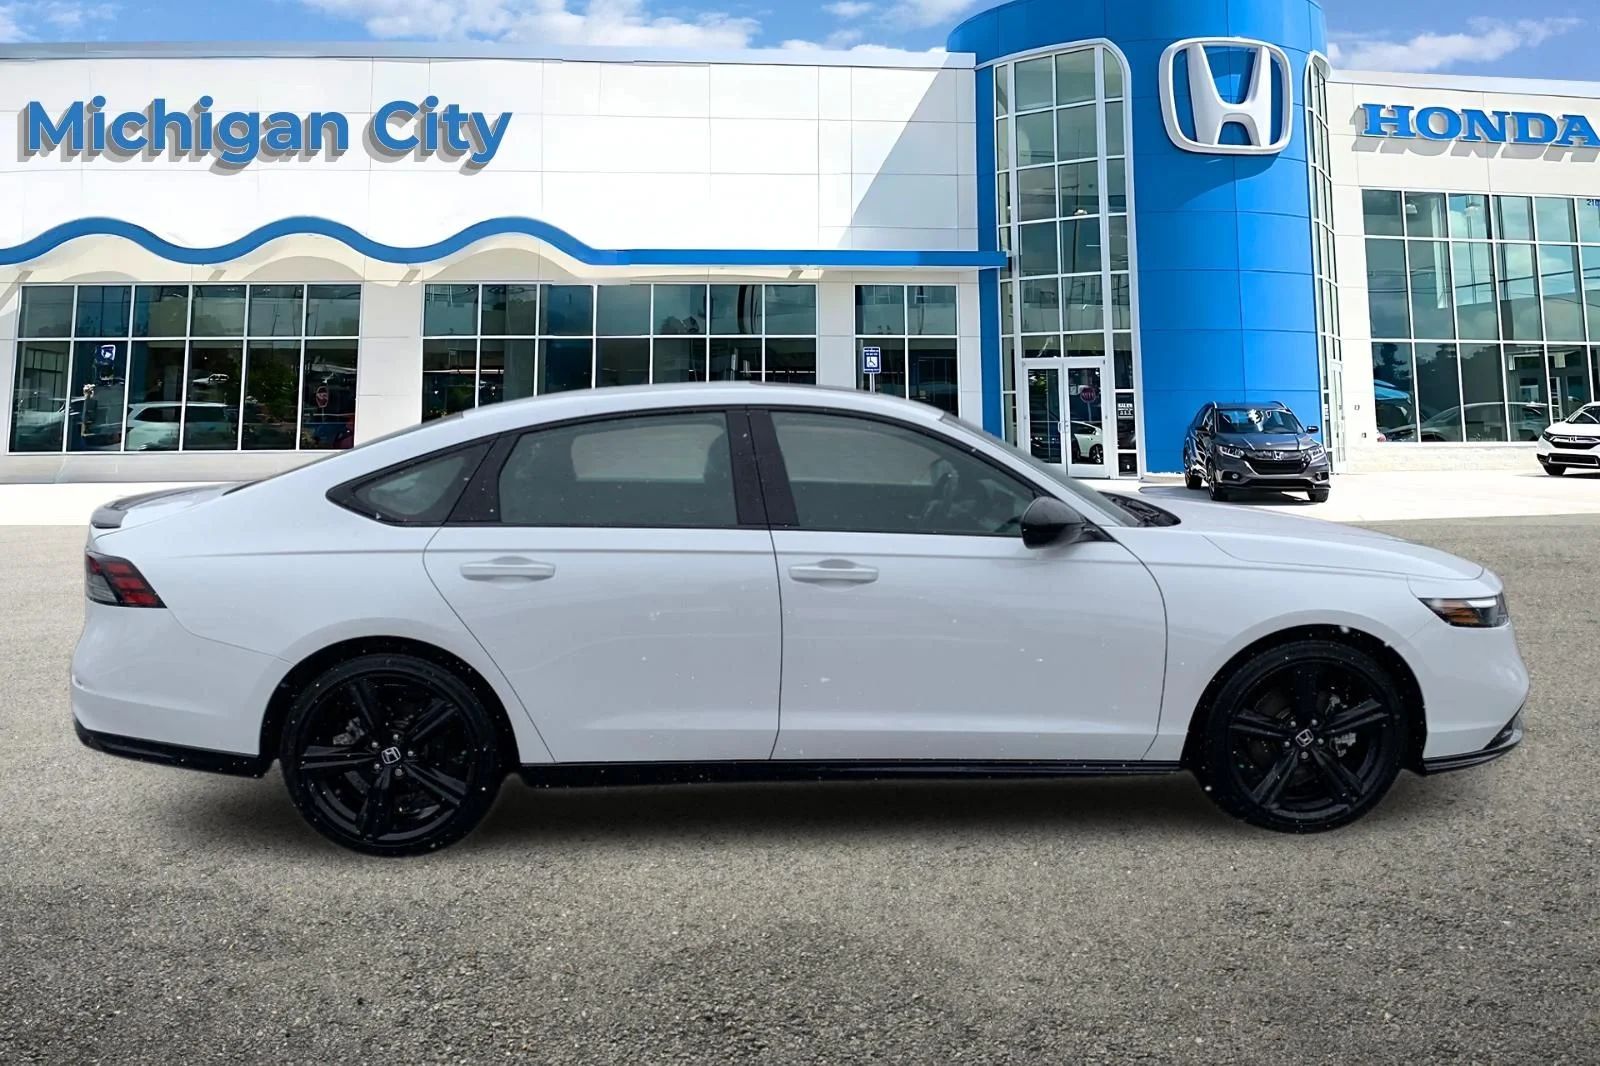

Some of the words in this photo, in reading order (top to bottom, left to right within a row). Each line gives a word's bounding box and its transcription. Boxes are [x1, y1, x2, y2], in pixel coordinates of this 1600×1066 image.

[29, 96, 348, 163] Michigan
[375, 96, 511, 163] City
[1362, 104, 1600, 147] HONDA
